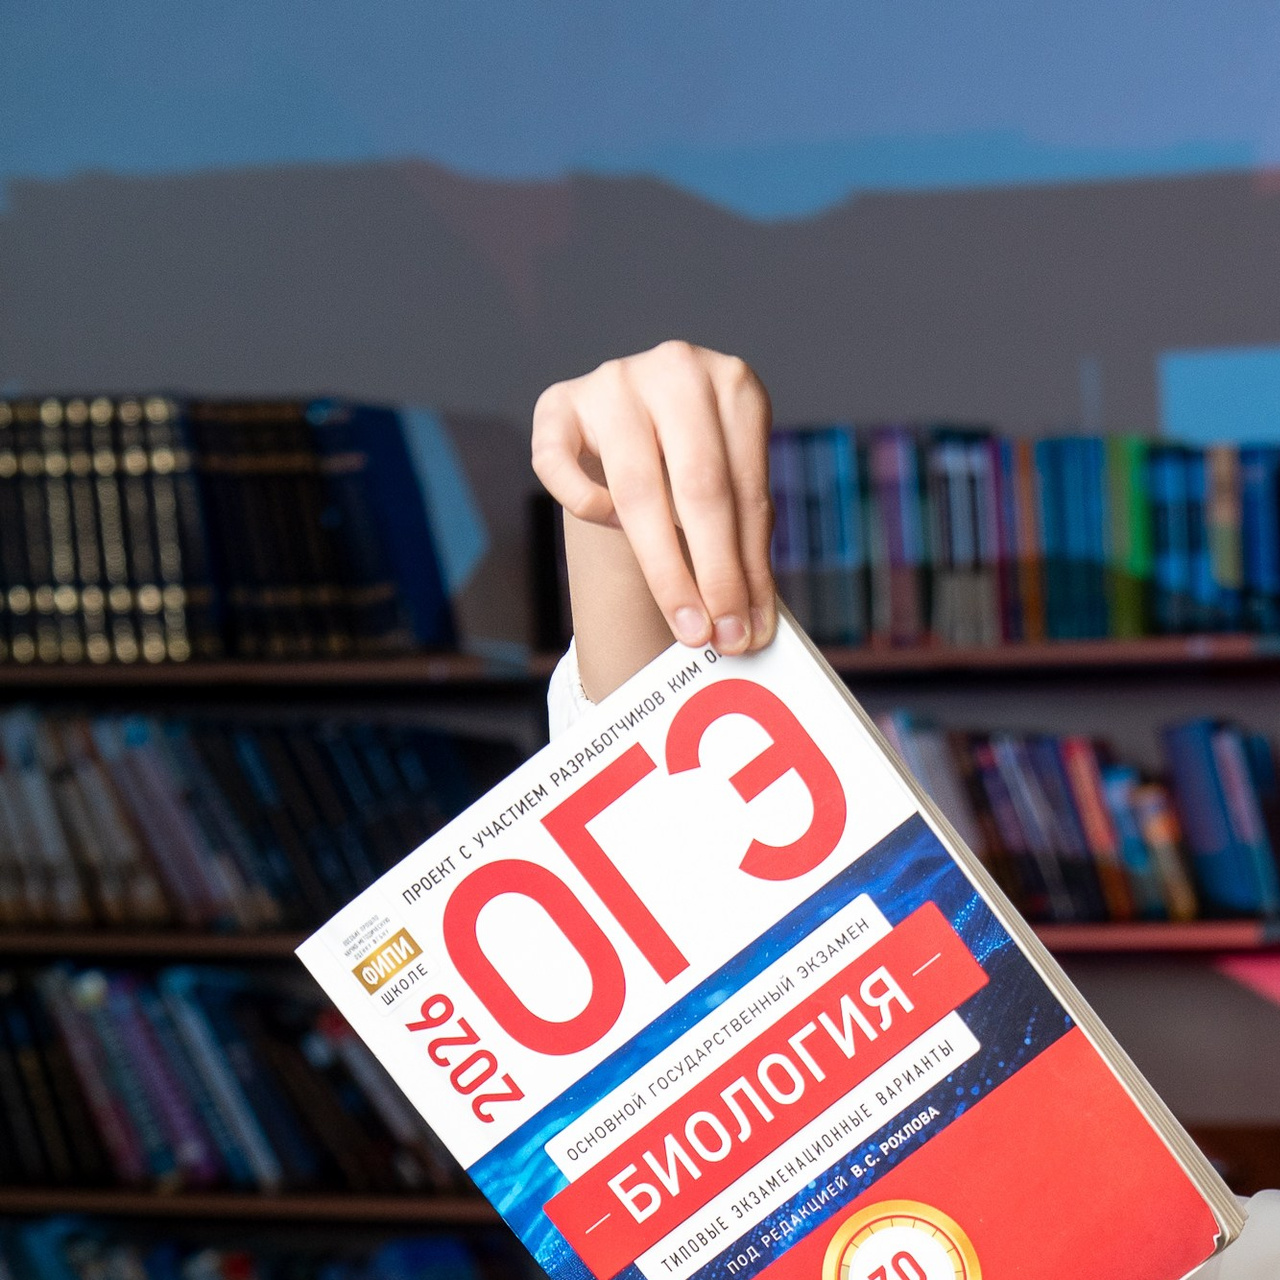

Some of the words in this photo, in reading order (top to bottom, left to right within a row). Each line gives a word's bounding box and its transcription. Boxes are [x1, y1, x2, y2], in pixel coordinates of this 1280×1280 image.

[402, 856, 456, 905] ПРОЕКТ
[459, 845, 472, 859] С
[472, 784, 549, 848] УЧАСТИЕМ
[549, 691, 665, 787] РАЗРАБОТЧИКОВ
[667, 661, 702, 693] КИМ
[442, 678, 848, 1057] ОГЭ
[362, 936, 414, 985] ФИПИ
[381, 963, 428, 1006] ШКОЛЕ
[405, 993, 525, 1124] 2026
[567, 1094, 647, 1161] ОСНОВНОЙ
[648, 977, 795, 1097] ГОСУДАРСТВЕННЫЙ
[797, 918, 869, 978] ЭКЗАМЕН
[607, 965, 914, 1224] БИОЛОГИЯ
[661, 1216, 729, 1272] ТИПОВЫЕ
[731, 1103, 872, 1219] ЭКЗАМЕНАЦИОННЫЕ
[875, 1039, 954, 1106] ВАРИАНТЫ
[723, 1241, 763, 1278] ПОД
[755, 1171, 853, 1252] РЕДАКЦИЕЙ
[876, 1102, 943, 1158] РОХЛОВА
